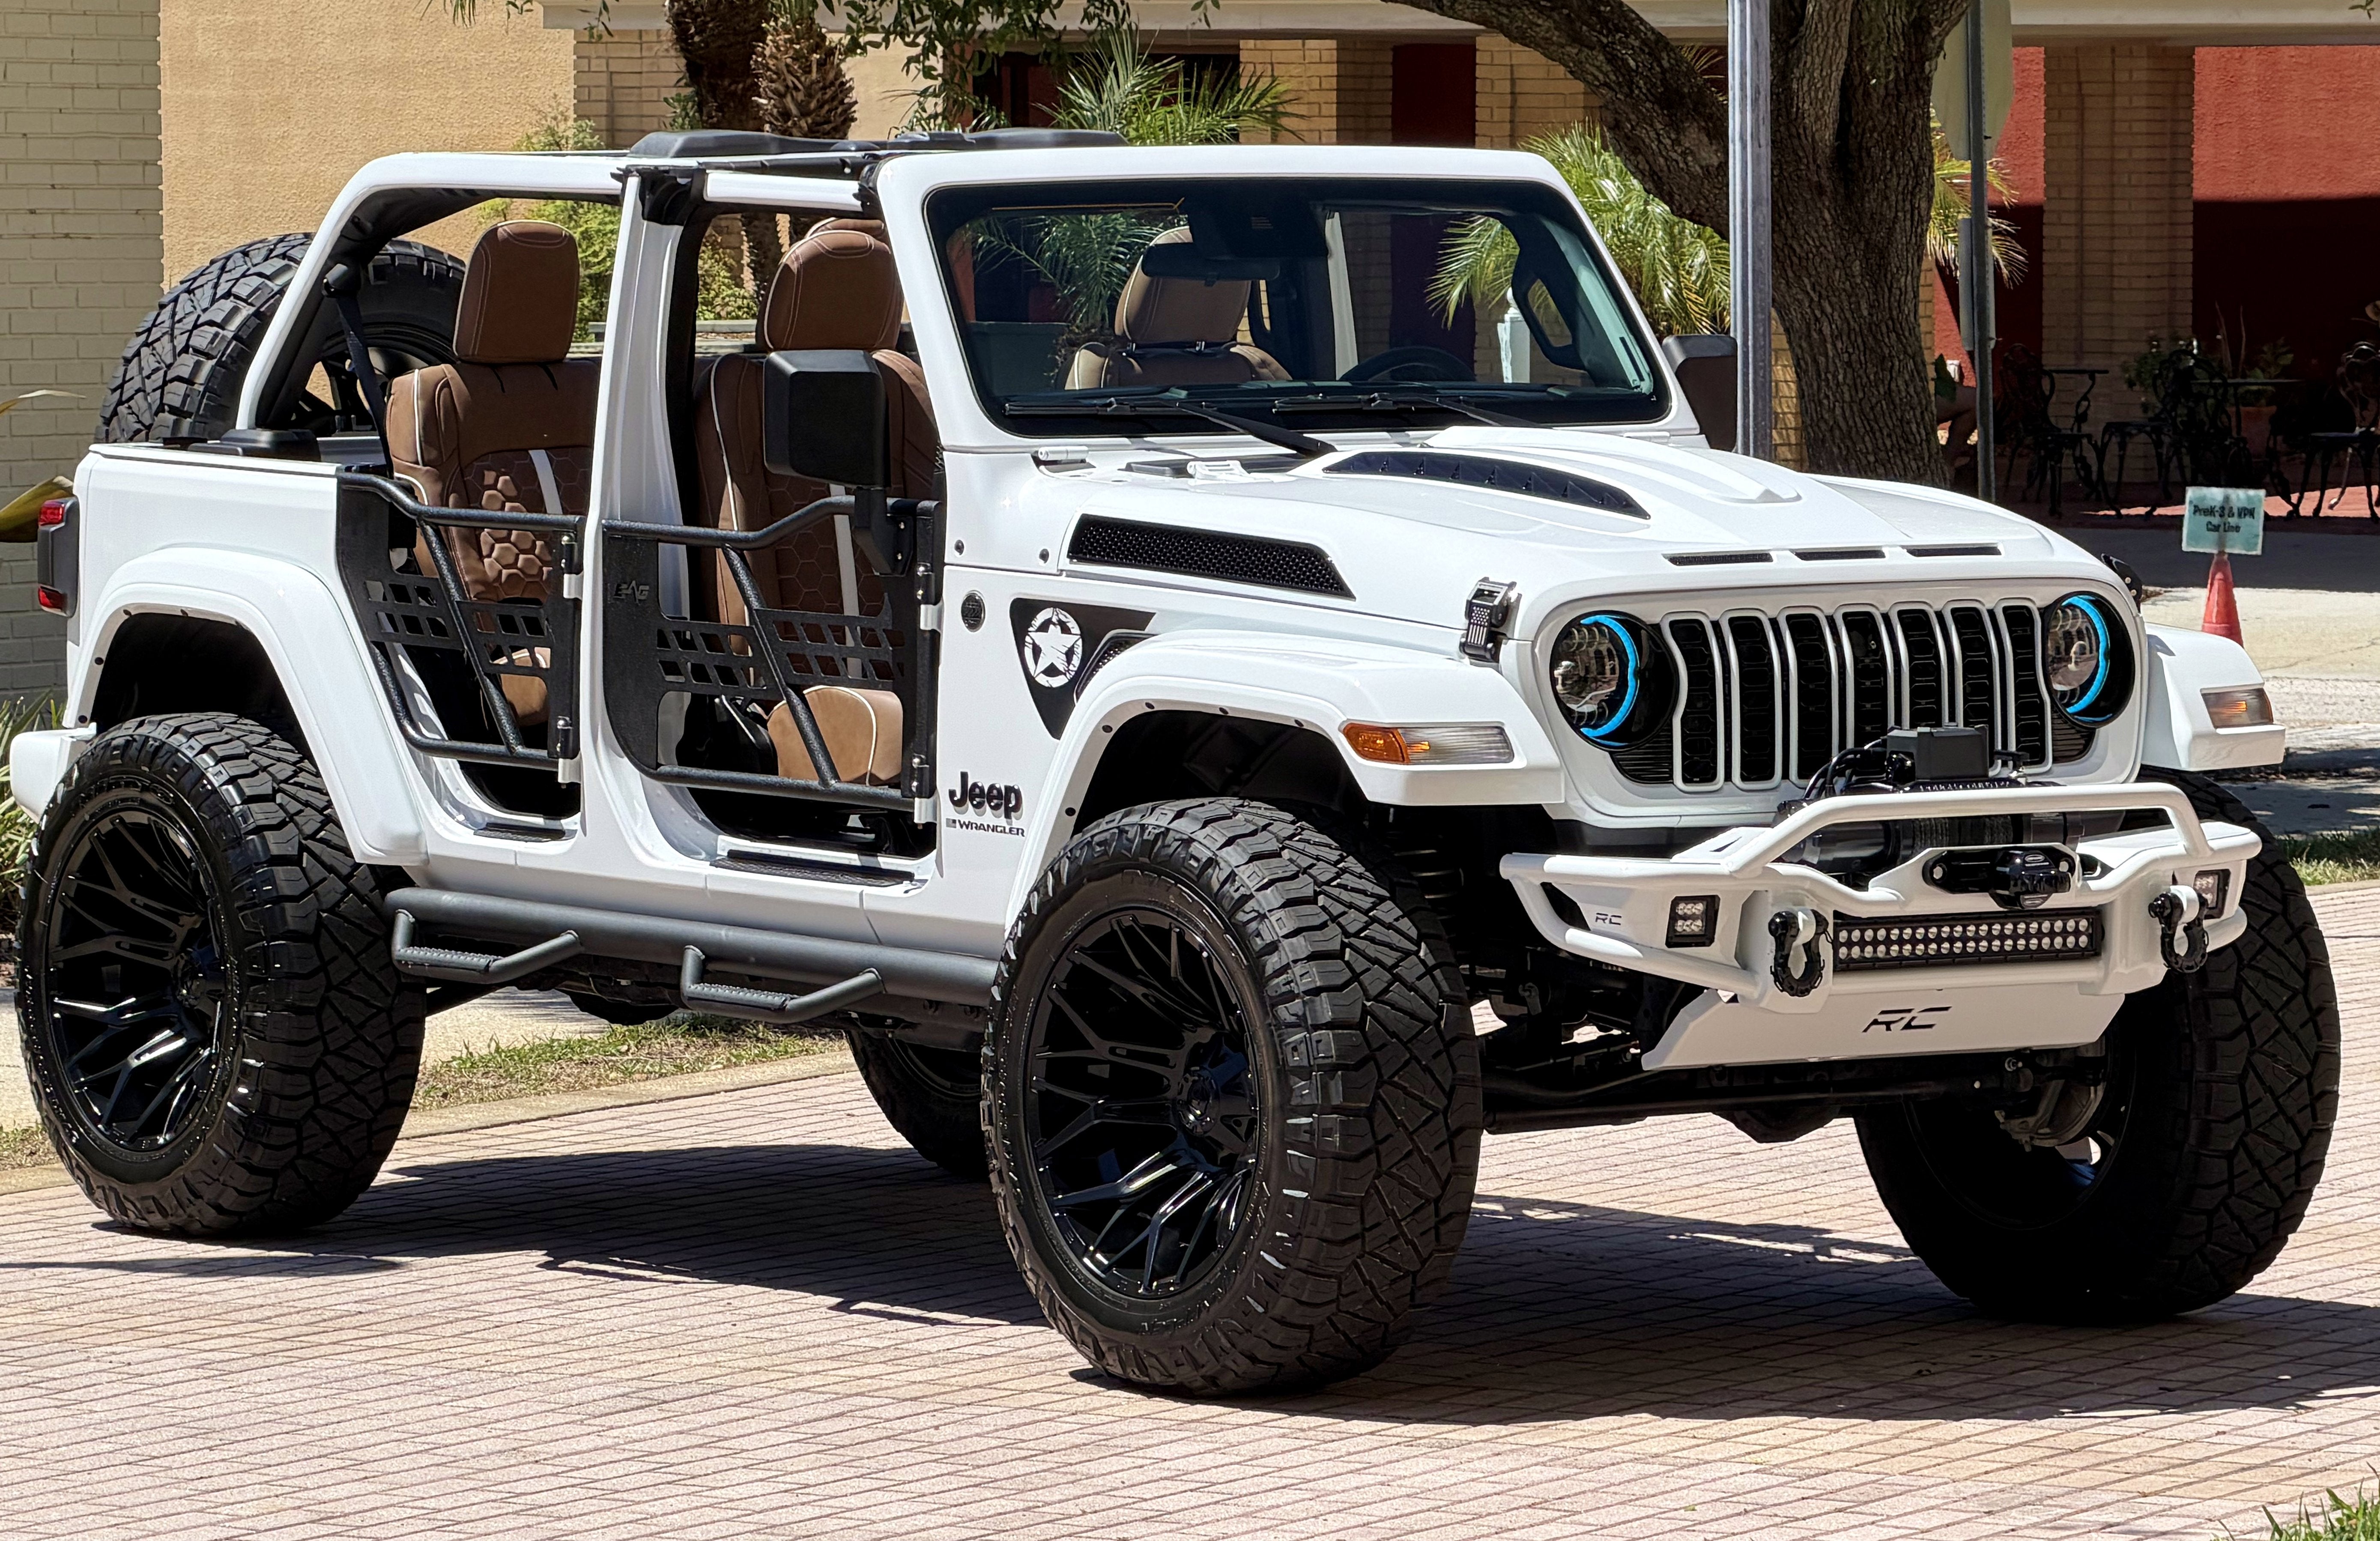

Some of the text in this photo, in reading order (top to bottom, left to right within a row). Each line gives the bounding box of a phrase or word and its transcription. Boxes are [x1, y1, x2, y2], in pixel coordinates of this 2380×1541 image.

[2206, 521, 2241, 532] Car Line
[949, 771, 1022, 819] Jeep
[958, 819, 1025, 837] WRANGLER
[1595, 913, 1622, 925] RC
[1862, 1006, 1953, 1033] RC
